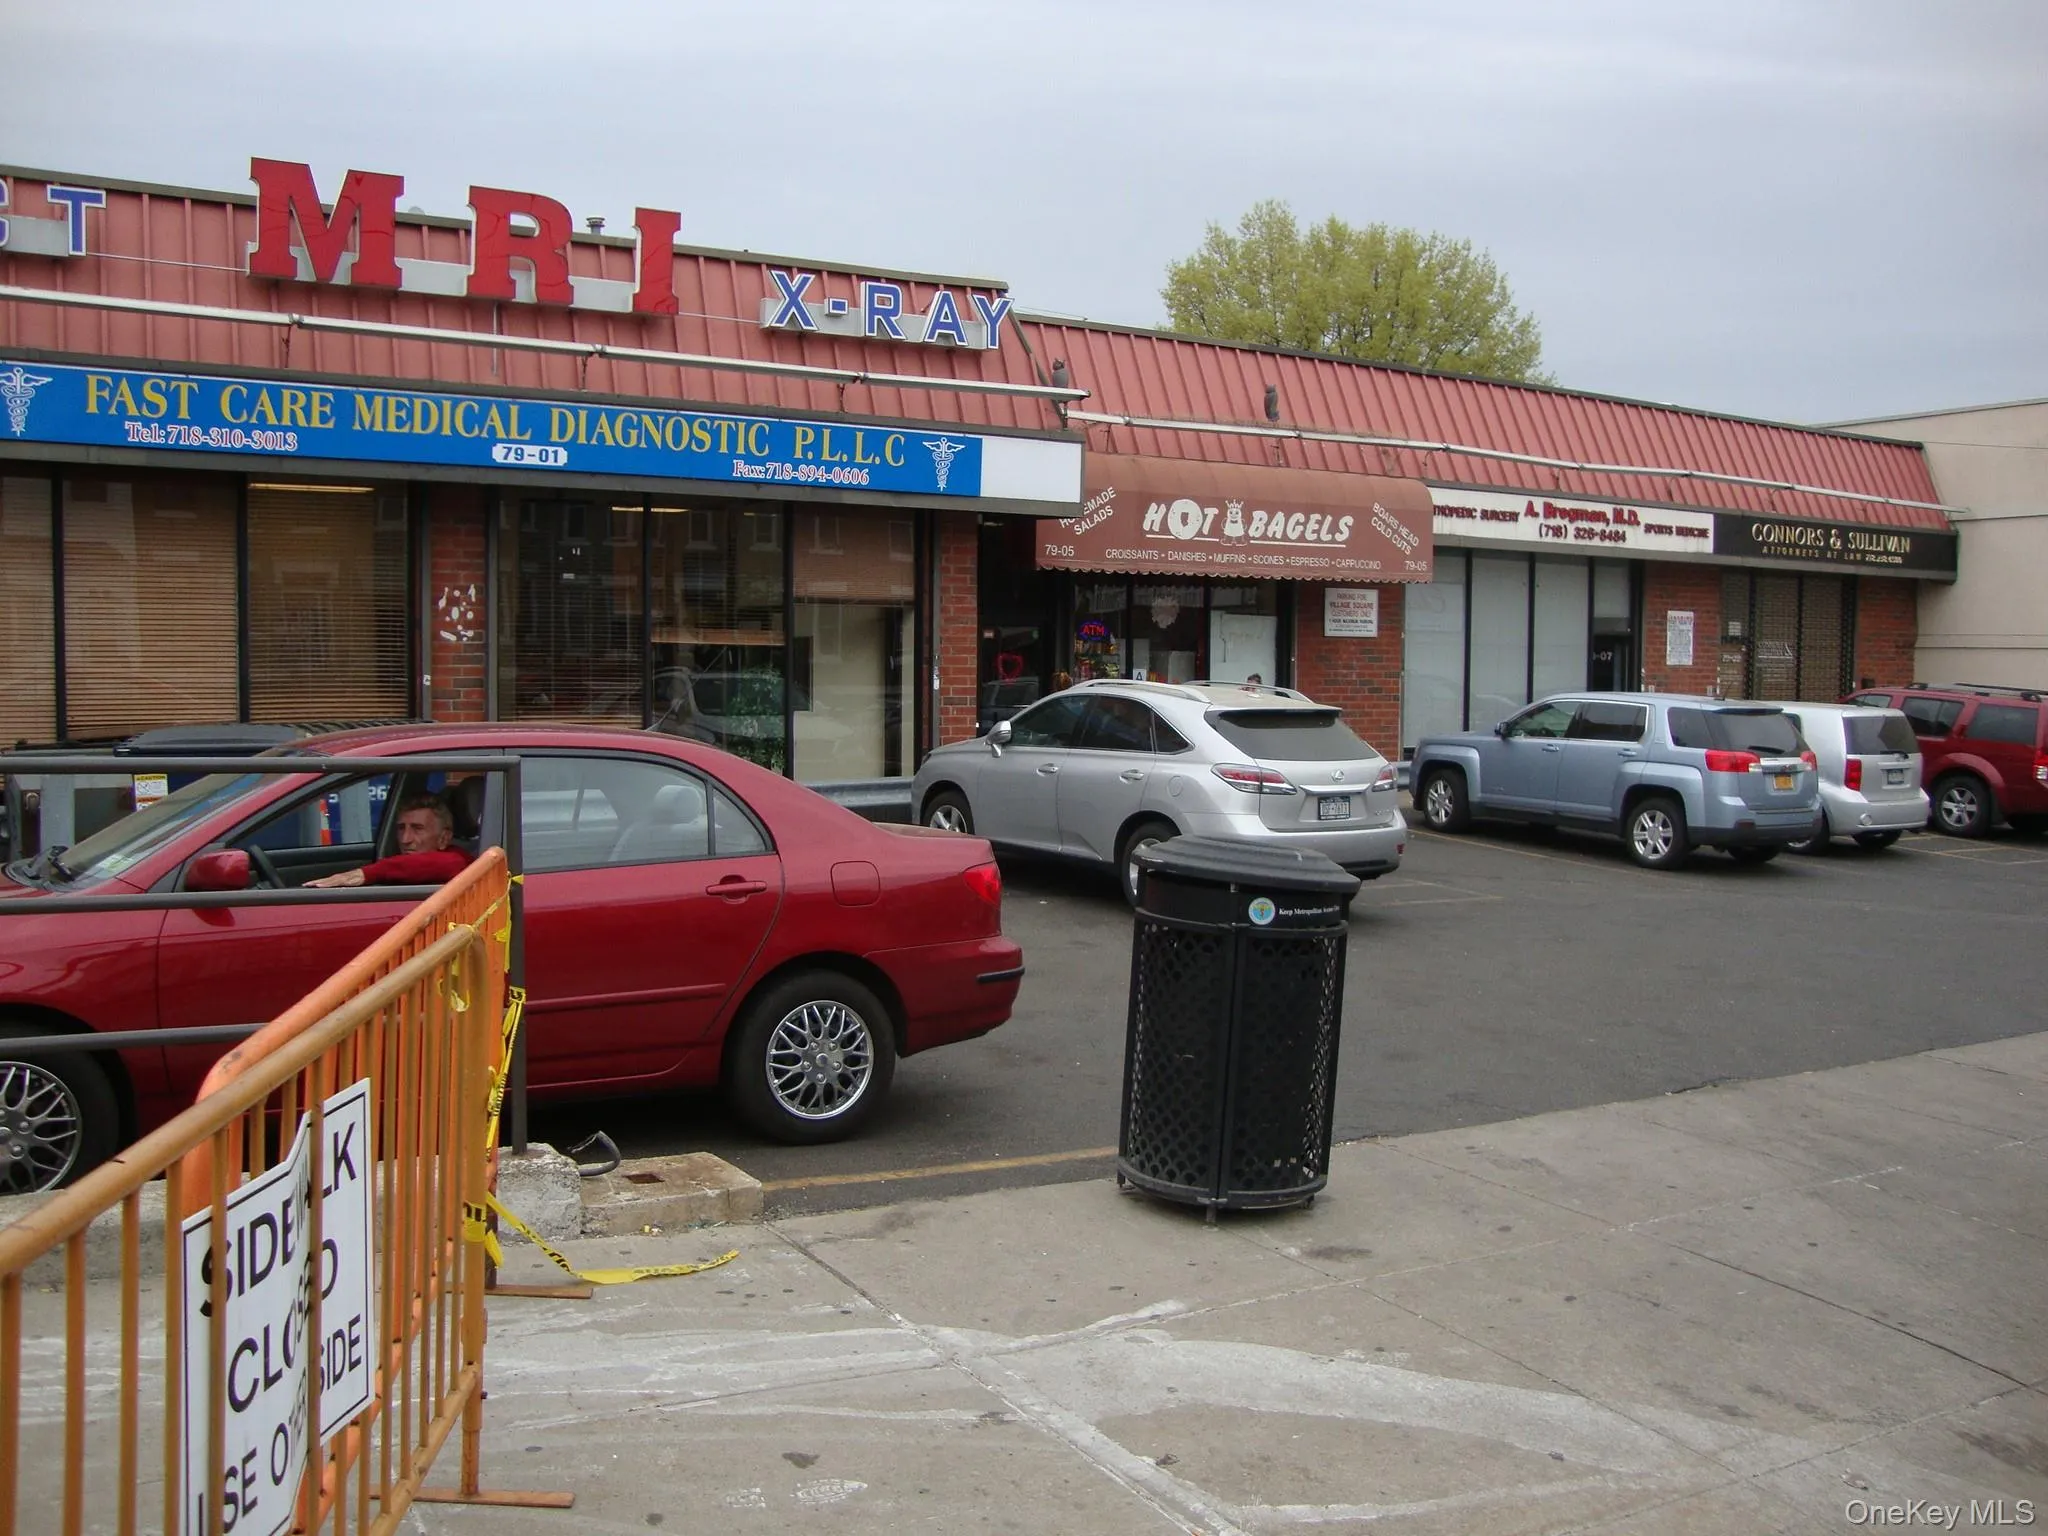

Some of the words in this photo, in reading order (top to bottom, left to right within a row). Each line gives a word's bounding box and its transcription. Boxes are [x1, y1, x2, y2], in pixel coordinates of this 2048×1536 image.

[249, 157, 681, 315] MRI
[767, 269, 1016, 350] X-RAY
[85, 374, 199, 420] FAST
[220, 384, 335, 429] CARE
[352, 394, 532, 440] MEDICAL
[550, 407, 770, 457] DIAGNOSTIC
[502, 446, 560, 463] 79-01
[1059, 486, 1116, 528] HEMADE
[1433, 504, 1478, 519] THOPEDIC
[1524, 500, 1539, 518] A.
[1612, 506, 1641, 527] M.D.
[1073, 505, 1115, 535] SALADS
[1142, 499, 1219, 540] HOT
[1248, 510, 1354, 542] BAGELS
[1372, 502, 1399, 529] BOARS
[1398, 524, 1420, 547] HEAD
[1539, 523, 1568, 539] (718)
[1644, 523, 1674, 536] SPORTS
[1371, 516, 1393, 539] COLD
[1391, 532, 1413, 556] CUTS
[1751, 522, 1825, 547] CONNORS
[1830, 528, 1843, 550] &
[1847, 531, 1911, 554] SULLIVAN
[1045, 544, 1075, 557] 79-05
[1105, 548, 1159, 560] CROISSANTS
[1167, 551, 1206, 562] DANISHES
[1213, 552, 1246, 563] MUFFINS
[1253, 554, 1284, 565] SCONES
[1290, 556, 1330, 568] ESPRESSO
[1336, 558, 1381, 570] CAPPUCCINO
[1762, 546, 1819, 558] ATTORNEYS
[1826, 550, 1839, 559] AT
[1404, 560, 1428, 571] 79-05
[1082, 624, 1105, 636] ATM
[1135, 671, 1143, 681] A
[1279, 907, 1293, 916] Keep
[198, 1447, 258, 1536] SE
